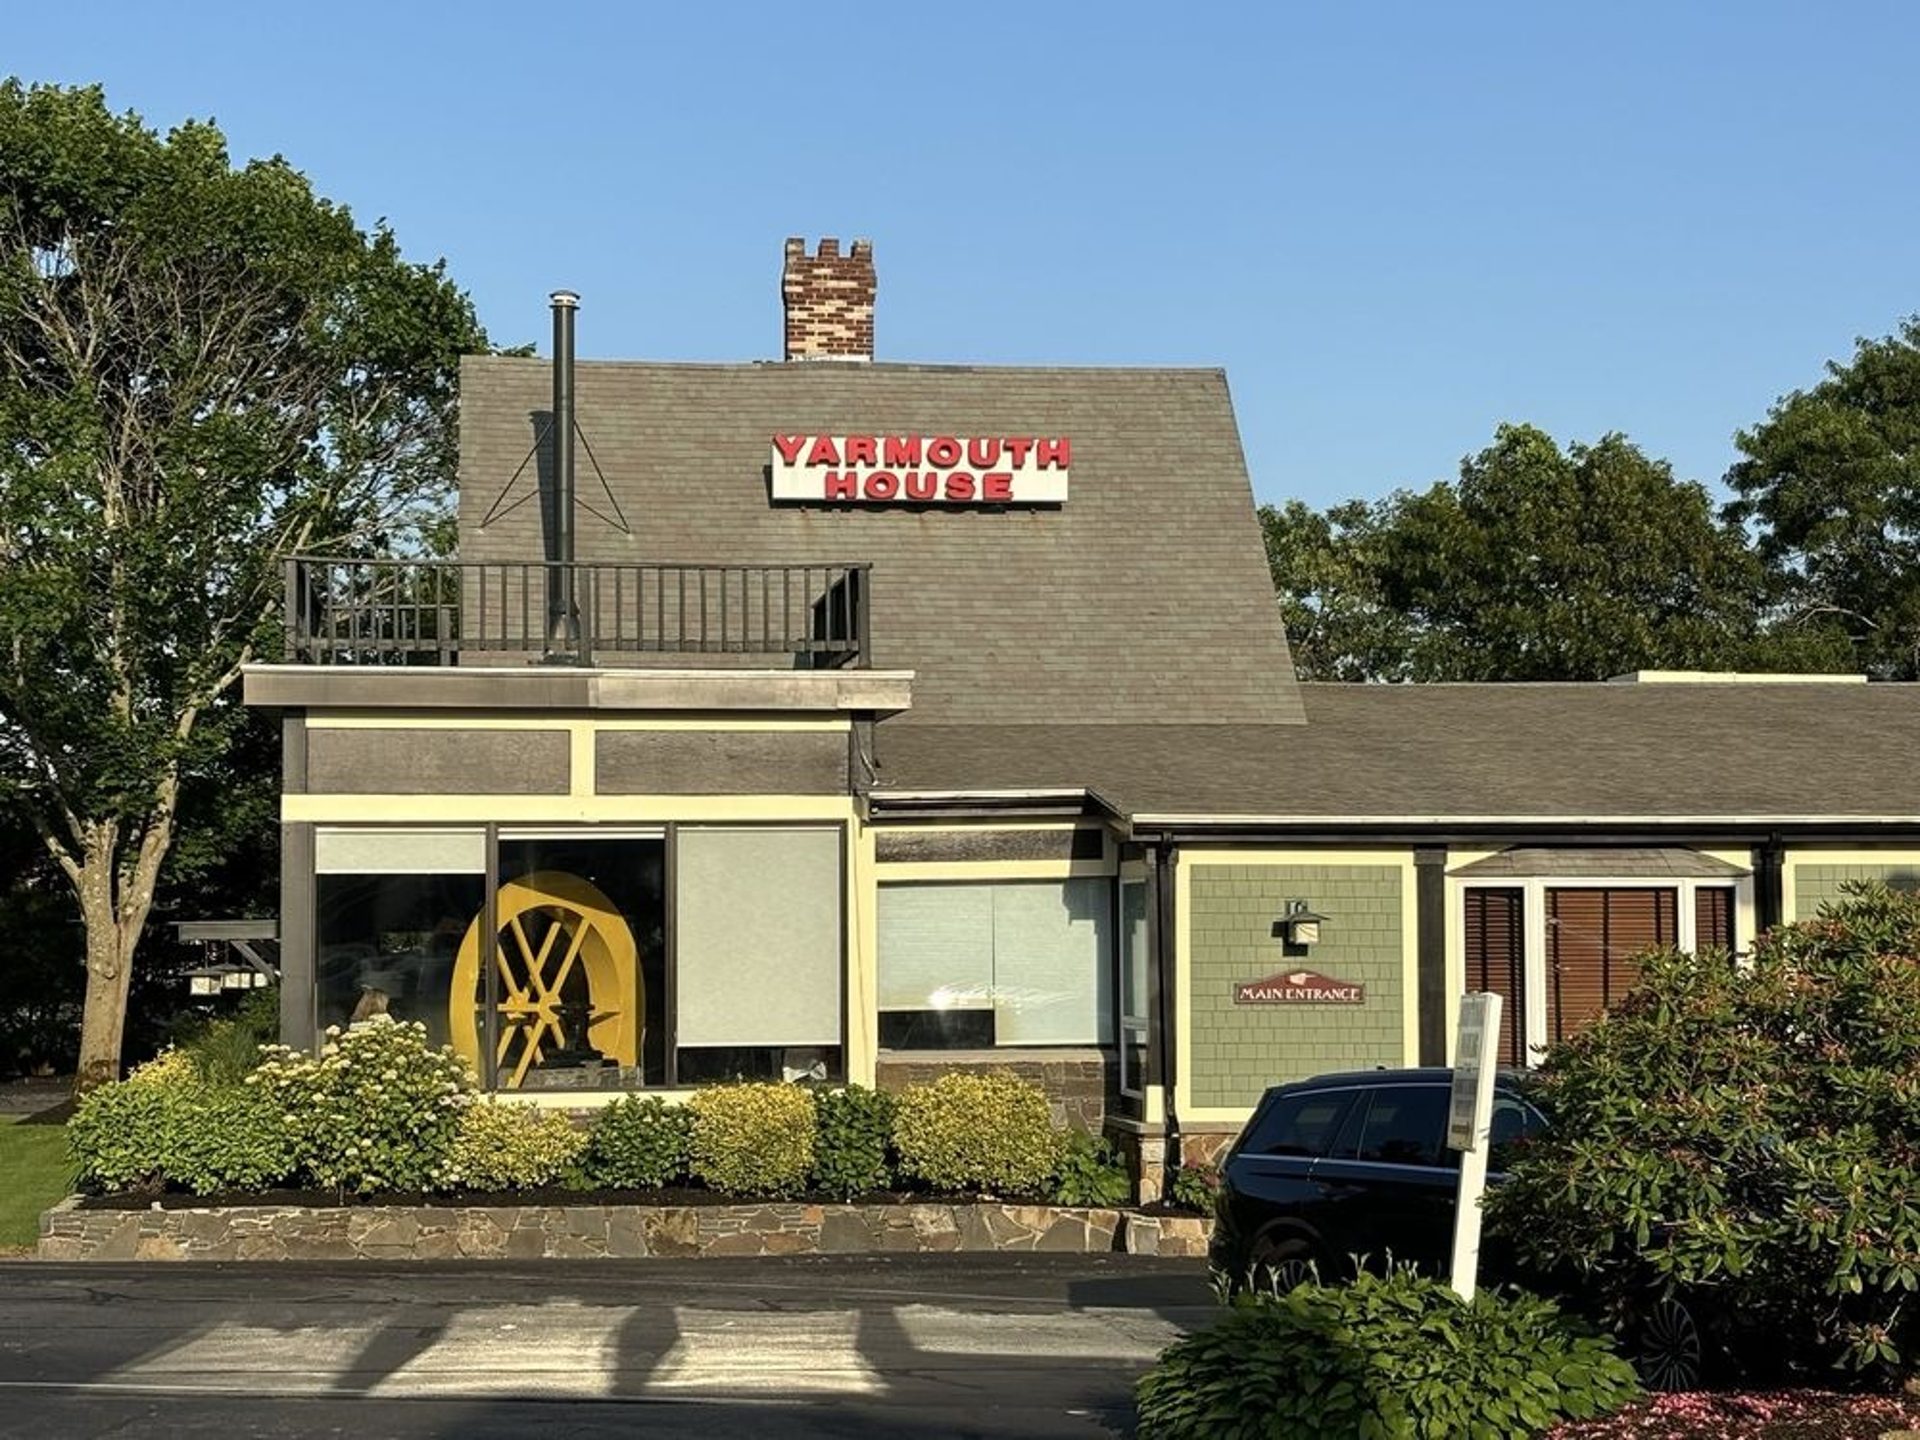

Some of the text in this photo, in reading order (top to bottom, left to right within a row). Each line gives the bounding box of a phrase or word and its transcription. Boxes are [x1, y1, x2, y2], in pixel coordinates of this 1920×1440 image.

[772, 433, 1071, 470] YARMOUTH
[824, 471, 1014, 502] HOUSE
[1240, 988, 1360, 999] MAIN ENTRANCE
